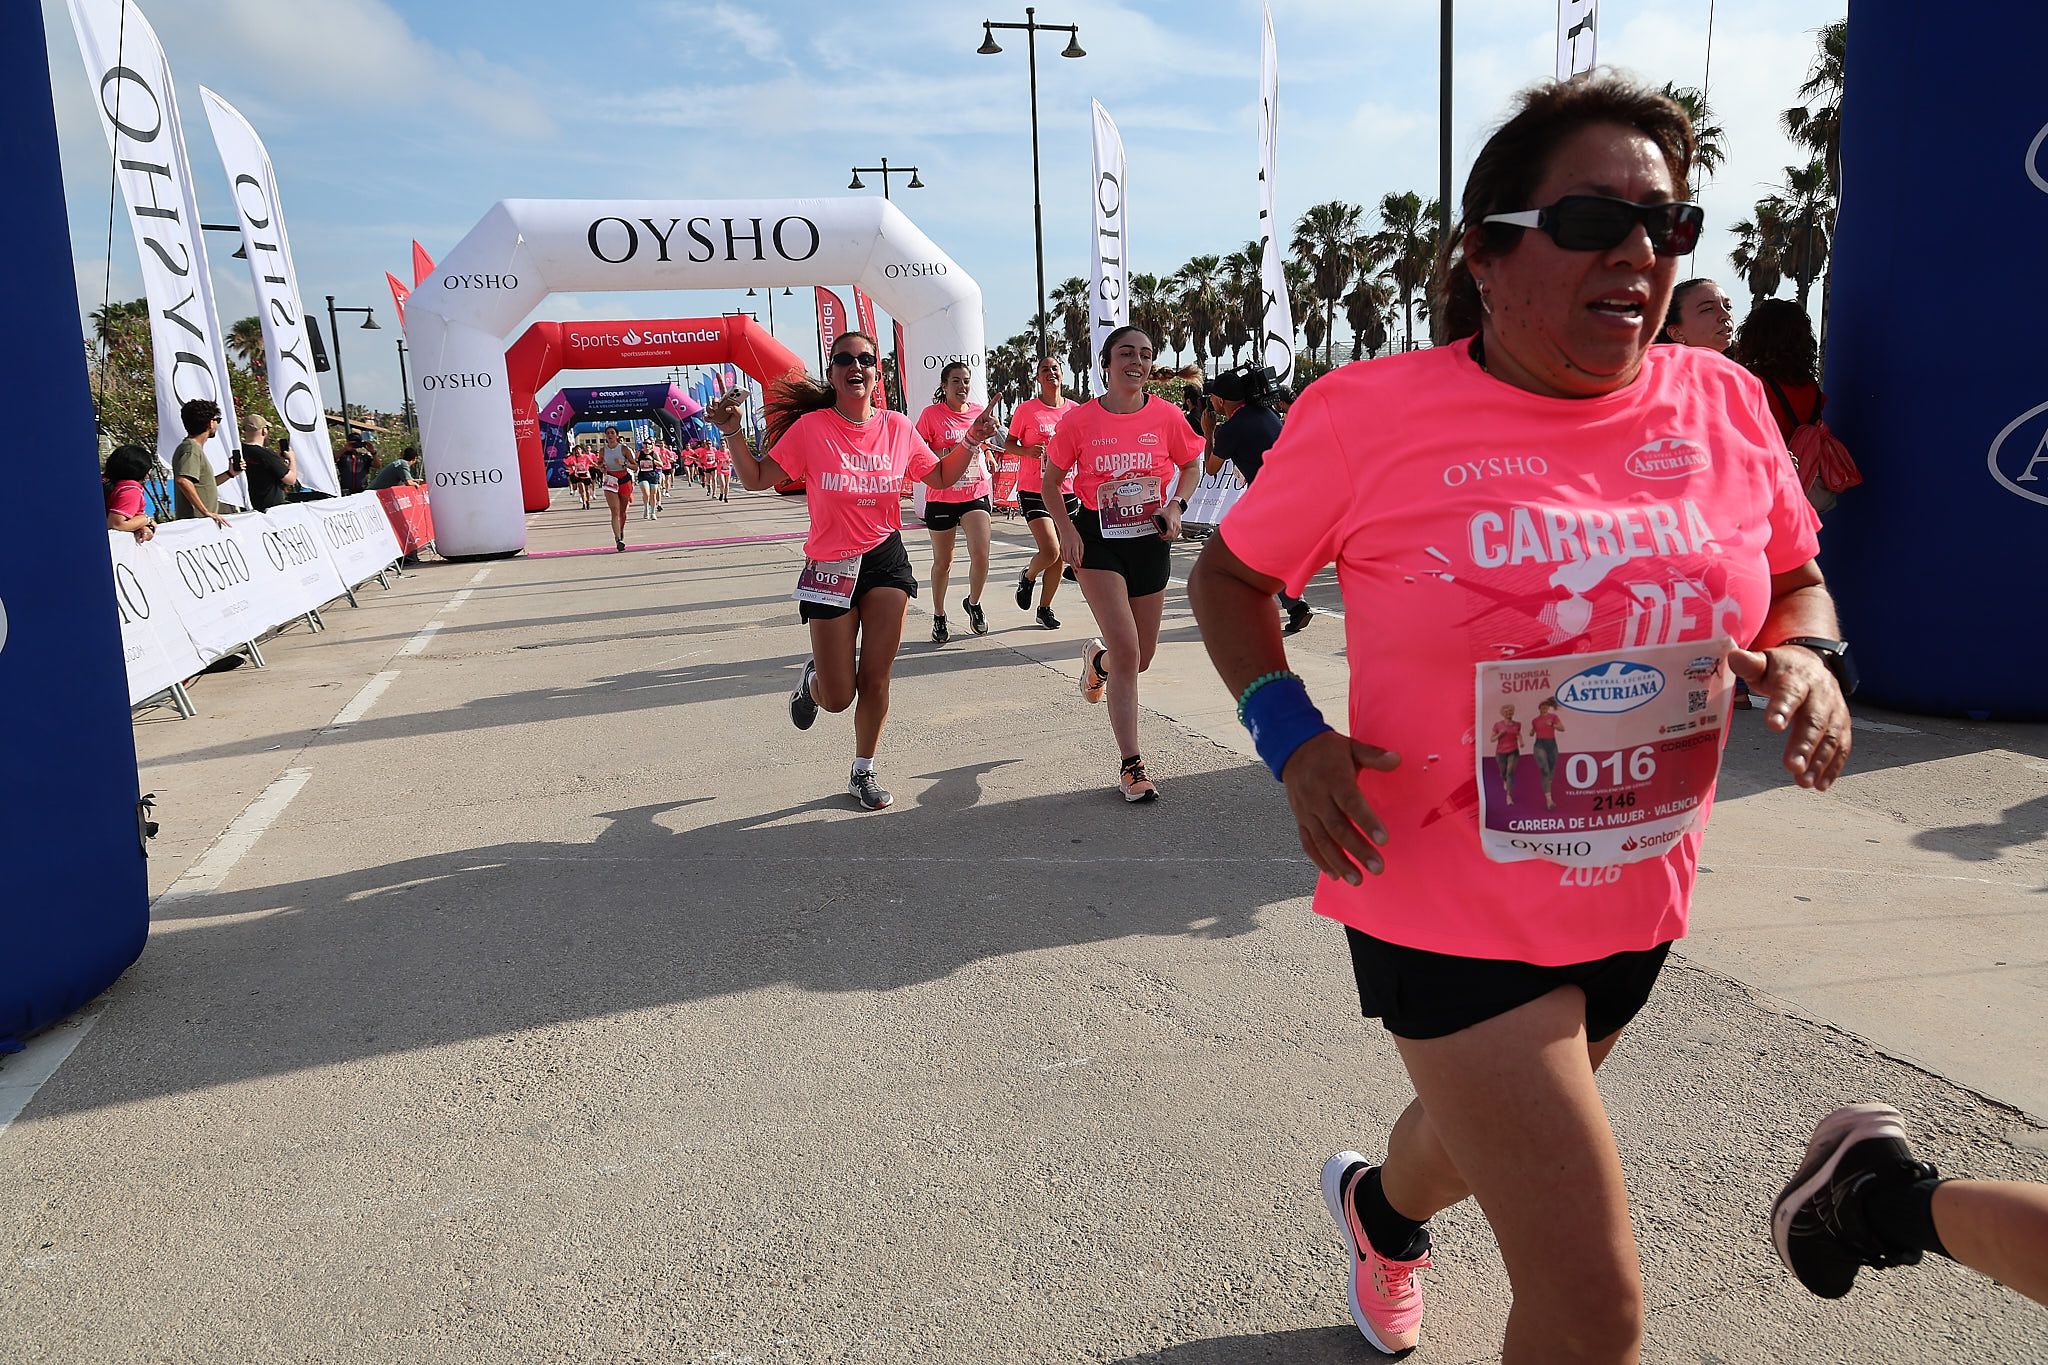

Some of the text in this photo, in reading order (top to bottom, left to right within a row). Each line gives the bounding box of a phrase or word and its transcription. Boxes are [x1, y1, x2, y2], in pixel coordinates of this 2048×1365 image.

[587, 215, 820, 264] OYSHO
[885, 263, 947, 278] OYSHO
[444, 274, 518, 290] OYSHO
[570, 329, 721, 350] Sports Santander
[423, 373, 492, 391] OYSHO
[1091, 437, 1118, 447] OYSHO
[841, 452, 892, 472] SOMOS
[1095, 452, 1152, 472] CARRERA
[1443, 456, 1548, 487] OYSHO
[1634, 453, 1708, 474] ASTURIANA
[435, 469, 503, 488] OYSHO
[821, 472, 903, 493] IMPARABLE
[1120, 505, 1144, 517] 016
[1467, 499, 1723, 569] CARRERA
[176, 538, 250, 600] OYSHO
[815, 572, 839, 584] 016
[1499, 669, 1550, 681] TU DORSAL
[1502, 677, 1551, 694] SUMA
[1563, 680, 1658, 702] ASTURIANA
[1660, 734, 1717, 752] CORREDORA
[1565, 744, 1657, 790] 016
[1593, 791, 1637, 812] 2146
[1508, 796, 1699, 831] CARRERA DE LA MUJER VALENCIA
[1511, 839, 1592, 857] OYSHO
[1560, 863, 1622, 887] 2026
